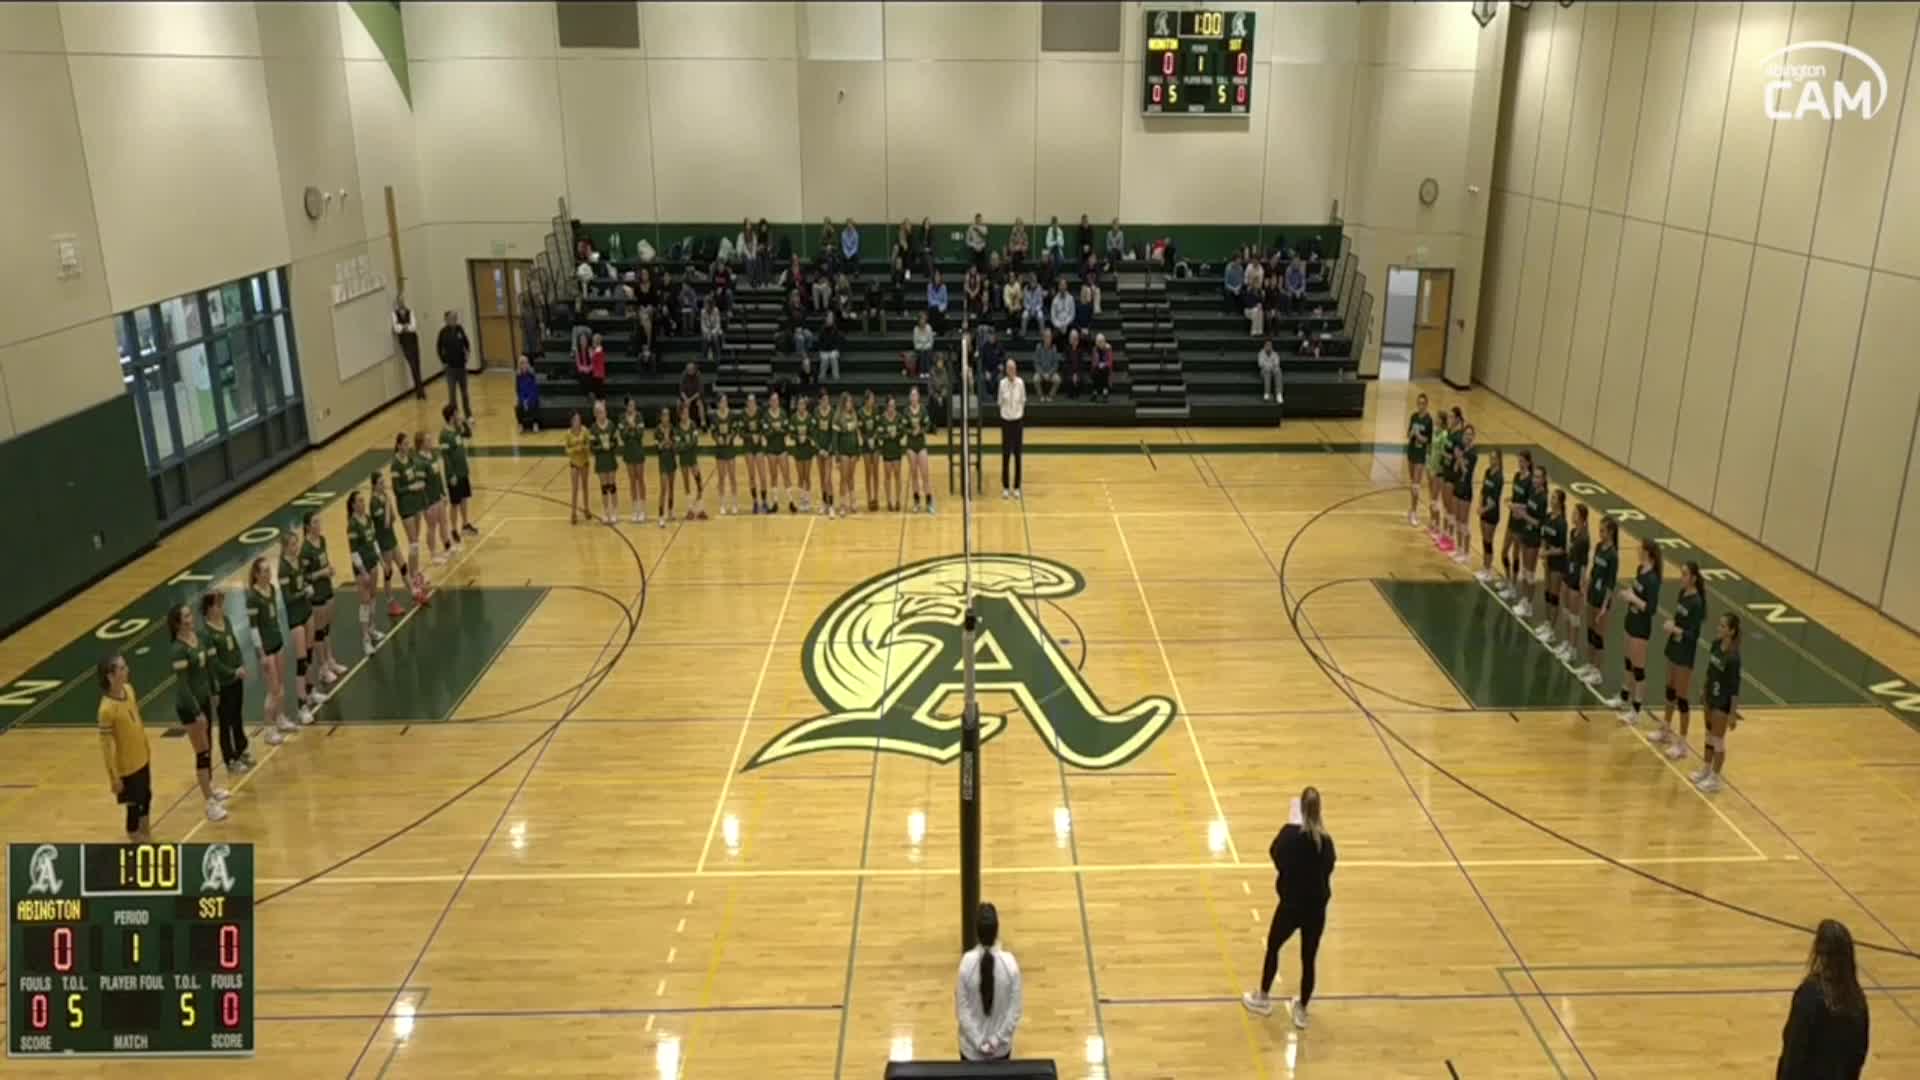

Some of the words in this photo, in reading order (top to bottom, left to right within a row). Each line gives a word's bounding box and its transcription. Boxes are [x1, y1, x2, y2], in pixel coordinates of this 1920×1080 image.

[1194, 12, 1221, 34] 1:00
[1163, 52, 1174, 75] 0
[1199, 55, 1204, 72] 1
[1237, 52, 1248, 75] 0
[1152, 84, 1162, 102] 0
[1168, 84, 1177, 103] 5
[1218, 84, 1226, 103] 5
[1236, 84, 1246, 103] 0
